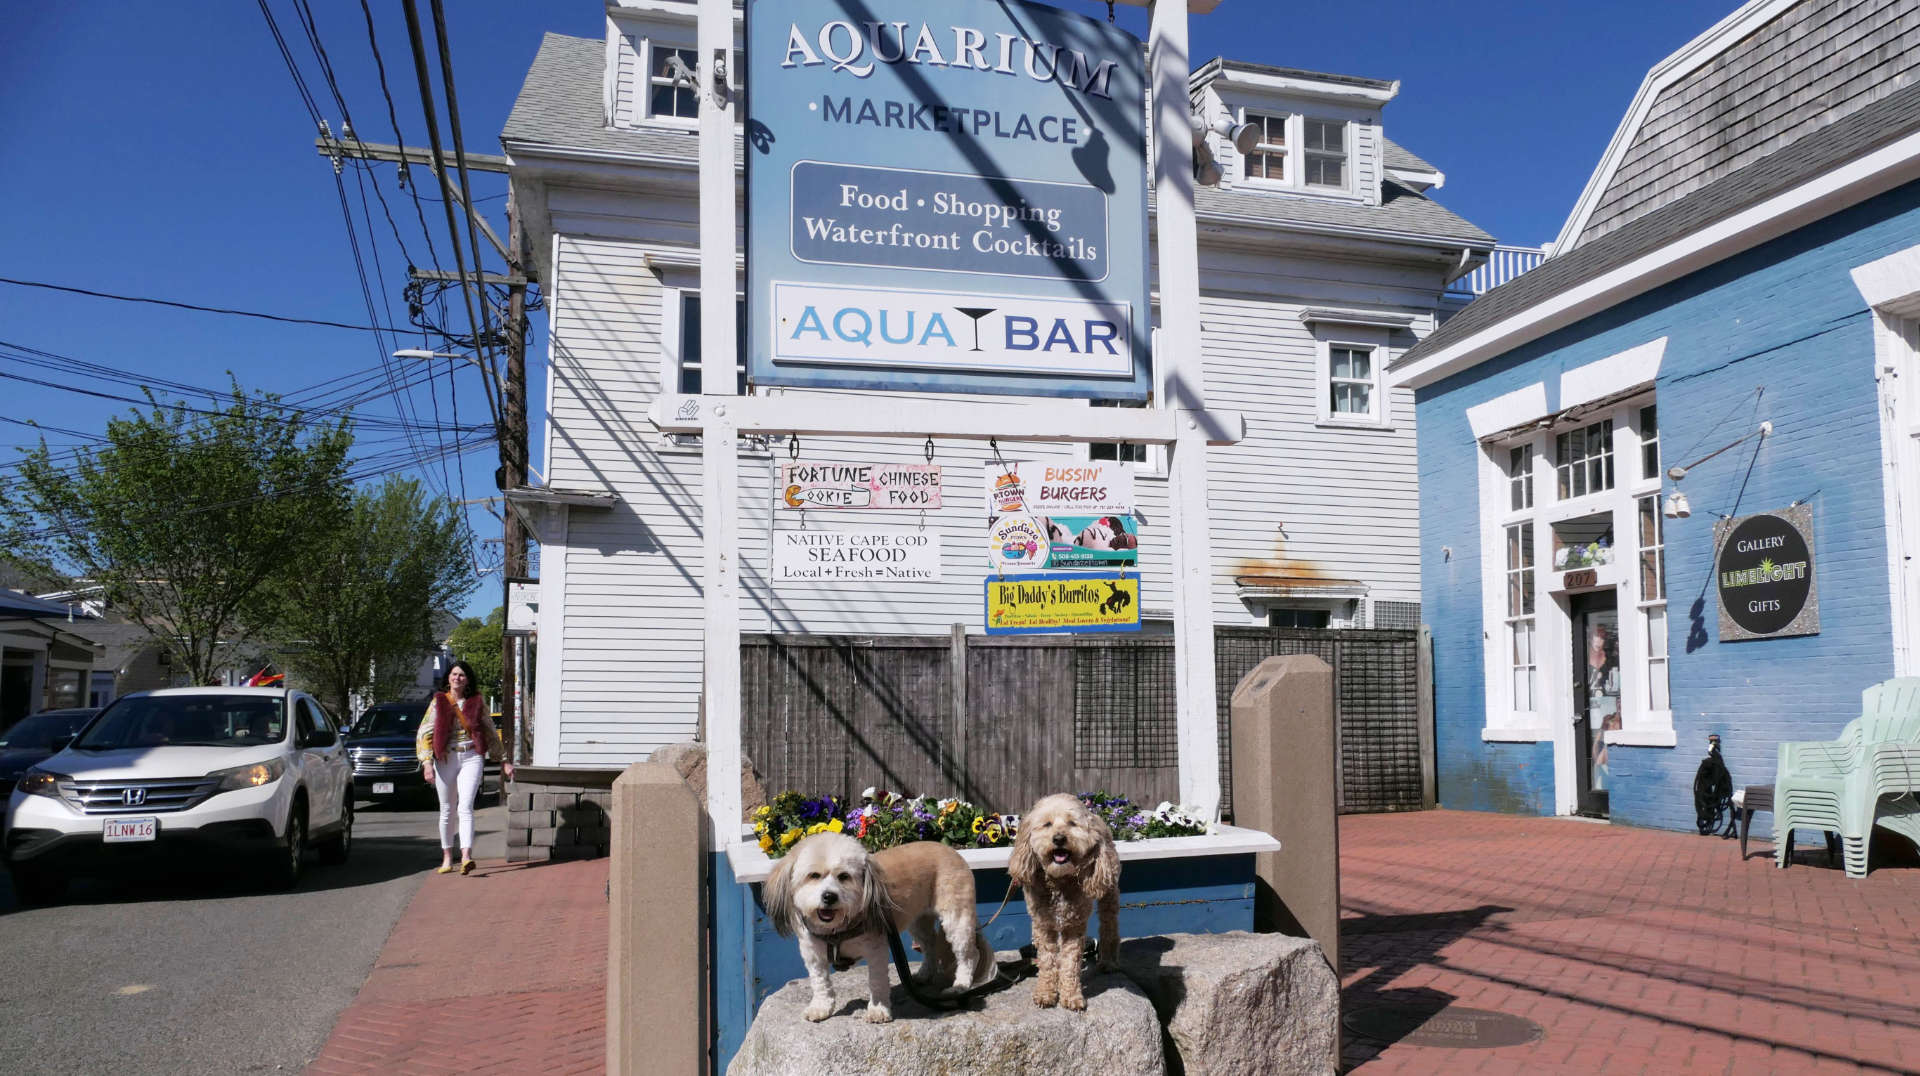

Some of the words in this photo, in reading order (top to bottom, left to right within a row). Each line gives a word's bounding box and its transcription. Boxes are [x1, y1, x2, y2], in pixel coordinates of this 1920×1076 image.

[781, 20, 1119, 100] AQUARIUM
[823, 95, 1078, 144] MARKETPLACE
[839, 184, 908, 211] Food
[934, 192, 1062, 232] Shopping
[803, 217, 960, 251] Waterfront
[973, 231, 1097, 261] Cocktails
[790, 306, 957, 348] AQUA
[1004, 315, 1120, 356] BAR
[788, 466, 872, 483] FORTUNE
[879, 472, 939, 486] CHINESE
[1045, 467, 1103, 482] BUSSIN'
[889, 490, 929, 505] FOOD
[1040, 486, 1107, 501] BURGERS
[998, 522, 1038, 540] Sundaze
[787, 534, 844, 546] NATIVE
[850, 535, 890, 546] CAPE
[895, 535, 928, 546] COD
[1737, 535, 1785, 552] GALLERY
[808, 548, 907, 562] SEAFOOD
[783, 566, 821, 578] Local
[835, 566, 873, 578] Fresh
[886, 566, 932, 578] Native
[1567, 572, 1591, 586] 207
[1721, 561, 1806, 588] LIMELIGHT
[1000, 585, 1016, 610] Big
[1018, 584, 1056, 609] Daddy's
[1057, 583, 1100, 605] Burritos
[1748, 599, 1781, 613] GIFTS
[107, 824, 136, 837] 1LNW
[139, 823, 153, 836] 16
